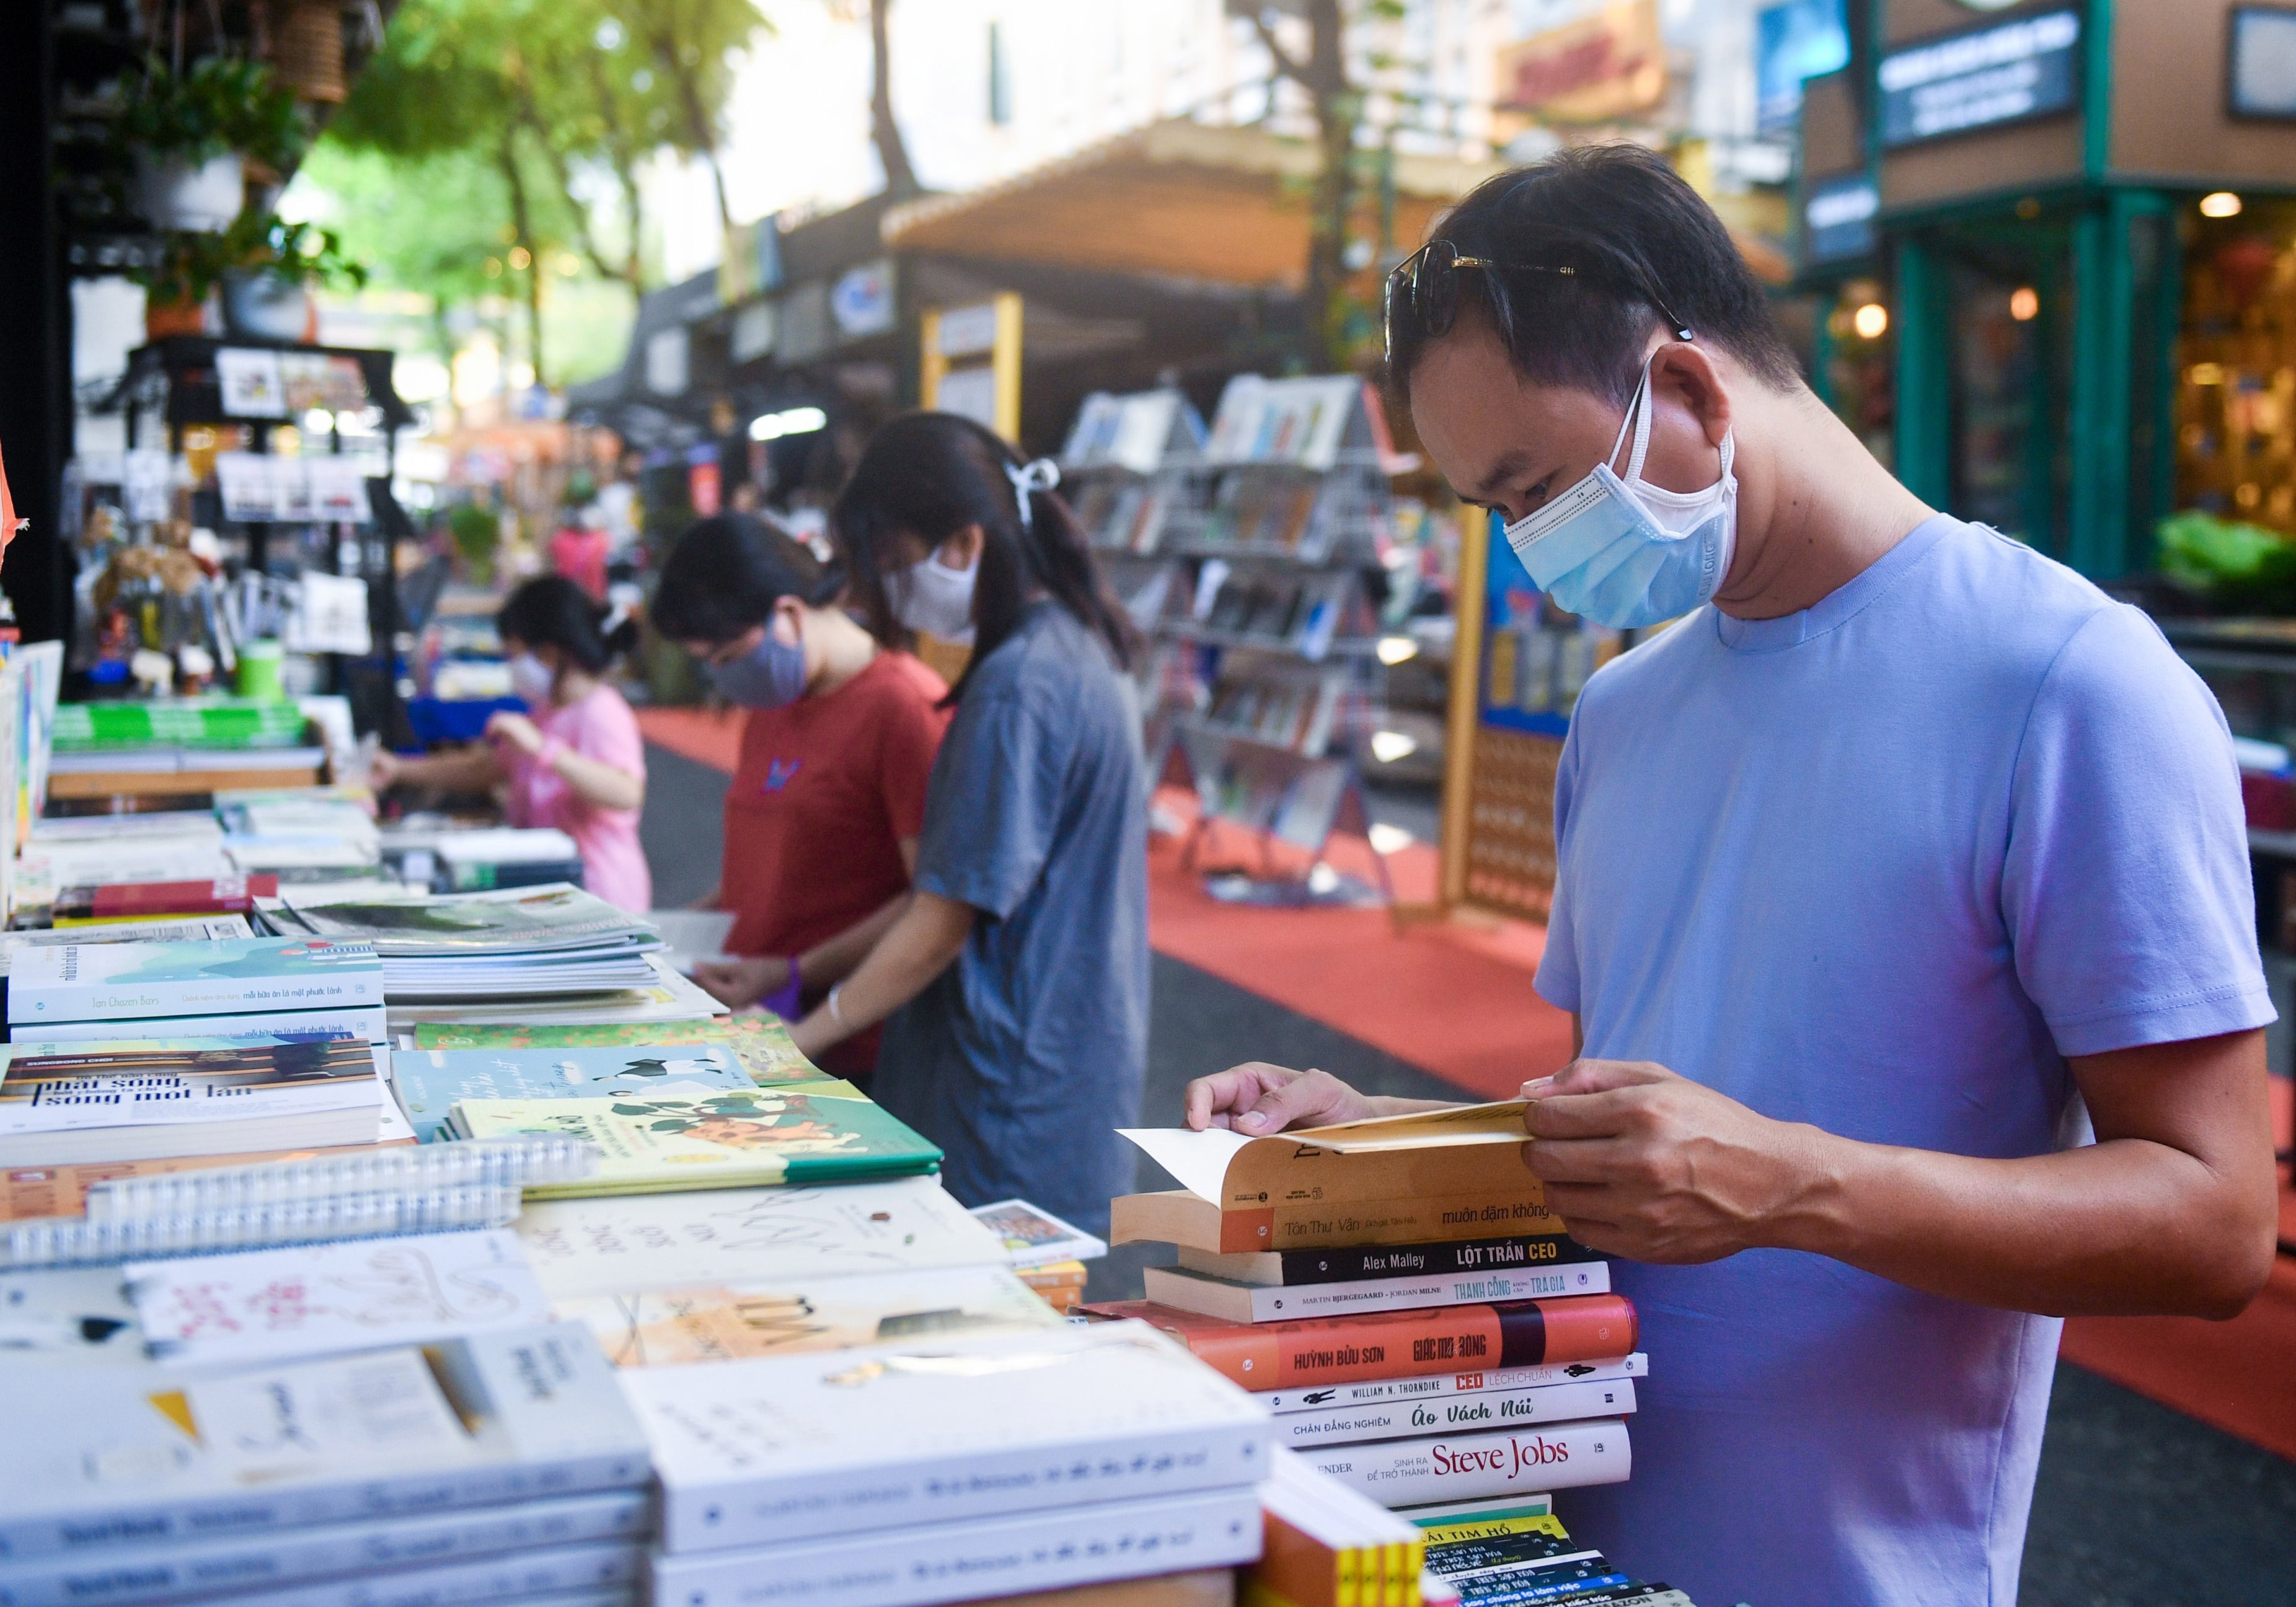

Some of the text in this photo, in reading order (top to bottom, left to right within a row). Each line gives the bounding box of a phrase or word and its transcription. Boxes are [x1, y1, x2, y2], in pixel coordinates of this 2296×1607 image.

[1705, 544, 1715, 575] LONG
[327, 987, 342, 995] lành
[92, 995, 159, 1008] Jan Chozen Bays
[1442, 1202, 1550, 1224] muôn dặm không
[1286, 1222, 1307, 1236] Tôn
[1310, 1220, 1333, 1234] Thư
[1338, 1217, 1360, 1232] Vân
[1363, 1253, 1425, 1270] Alex Malley
[1457, 1239, 1557, 1268] LỘT TRẦN CEO
[1302, 1296, 1331, 1305] MARTIN
[1332, 1291, 1384, 1303] BJERGEGAARD
[1390, 1288, 1418, 1299] JORDAN
[1419, 1287, 1441, 1295] MILNE
[1294, 1344, 1385, 1370] HUỲNH BỬU SƠN
[1352, 1381, 1441, 1399] WILLIAM N. THORNDIKE
[1456, 1372, 1484, 1391] CEO
[1411, 1398, 1534, 1427] Áo Vách Núi
[1354, 1416, 1391, 1429] NGHIÊM
[1394, 1457, 1428, 1468] SINH RA
[1433, 1434, 1570, 1479] Steve Jobs
[1318, 1463, 1353, 1475] ENDER
[1400, 1467, 1429, 1477] THÀNH
[1423, 1531, 1444, 1543] ÁI
[1448, 1529, 1482, 1539] TIM
